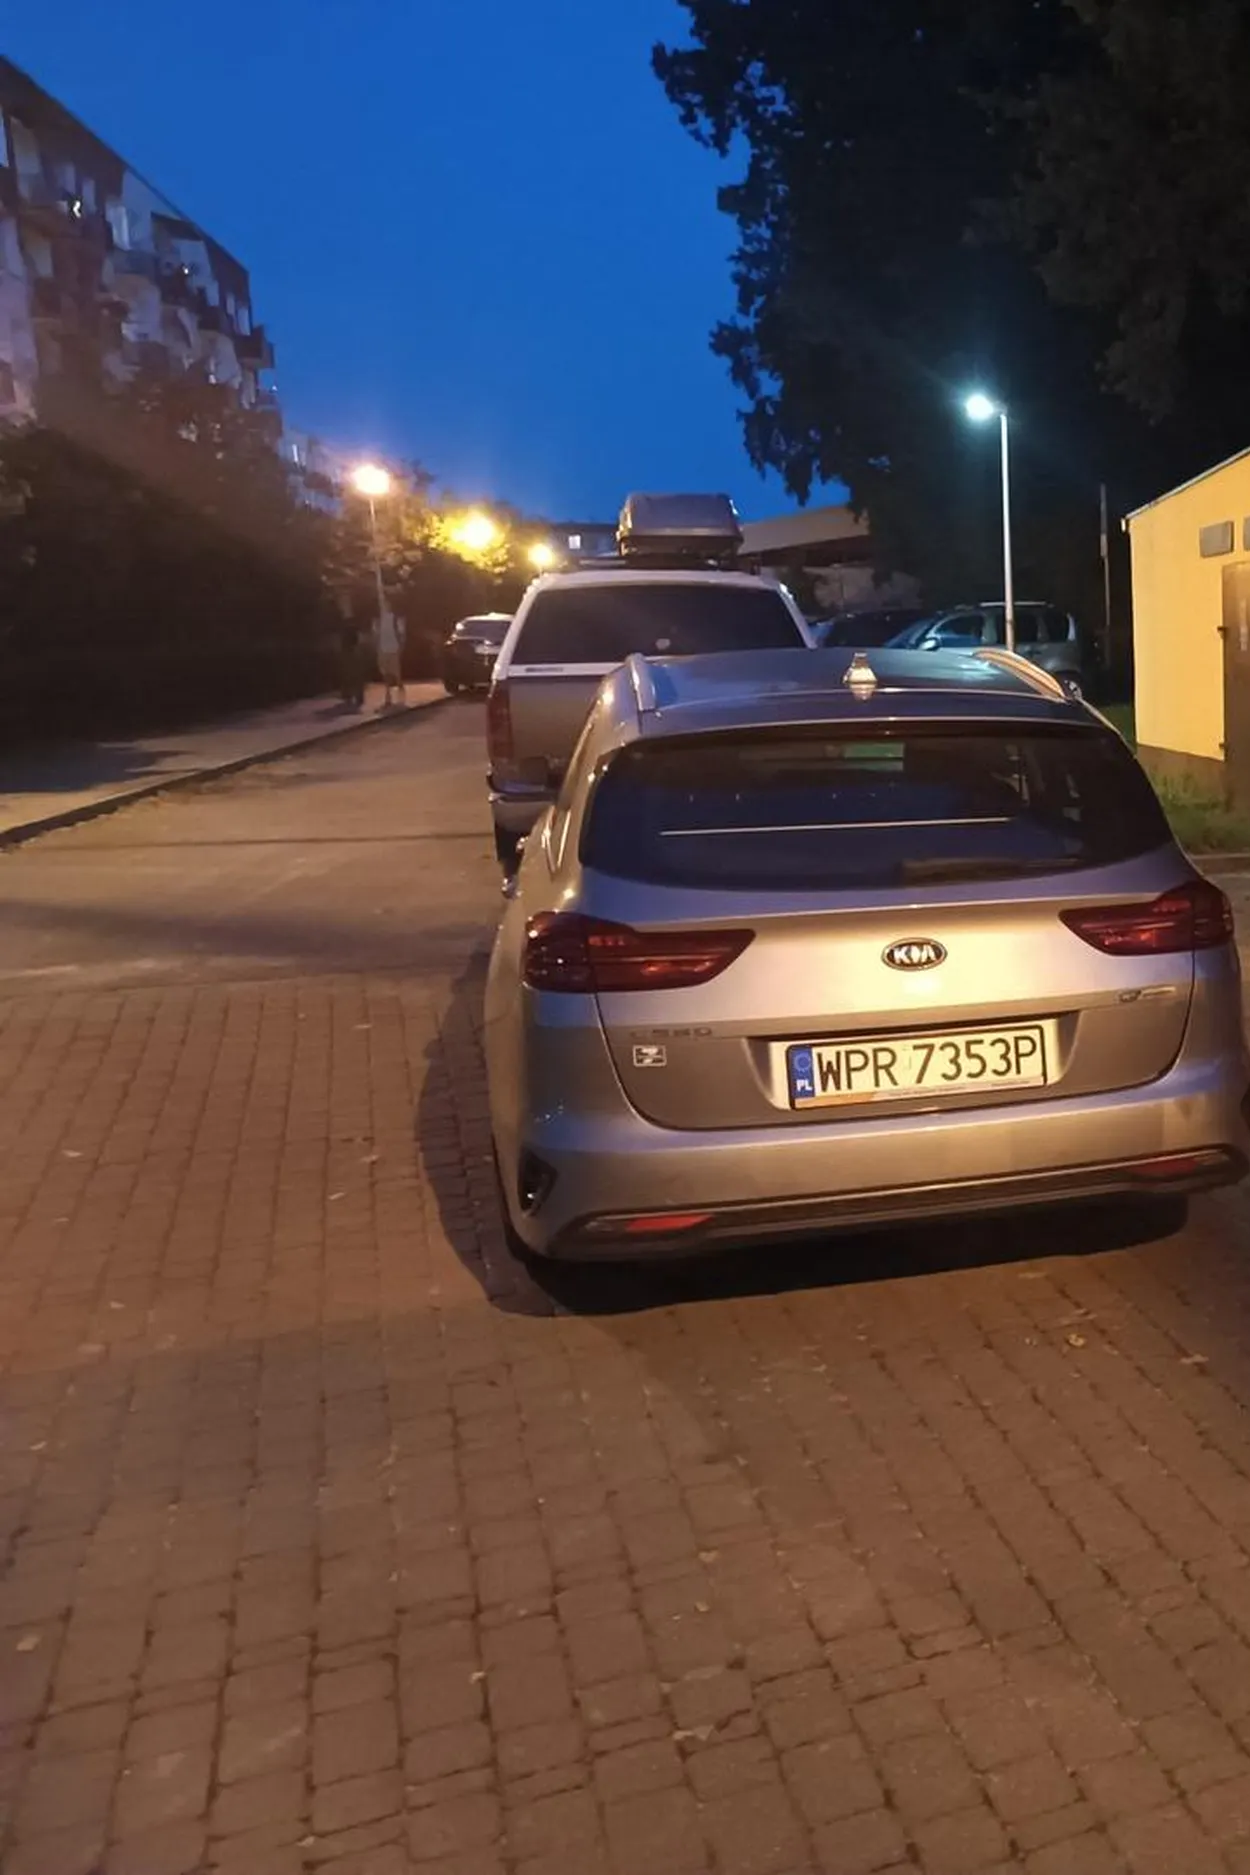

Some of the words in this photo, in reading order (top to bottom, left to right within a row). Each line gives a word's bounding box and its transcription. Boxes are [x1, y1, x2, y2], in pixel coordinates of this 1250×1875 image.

[893, 943, 937, 964] KIA
[816, 1047, 898, 1092] WPR
[912, 1035, 1037, 1084] 7353P
[796, 1079, 813, 1091] PL
